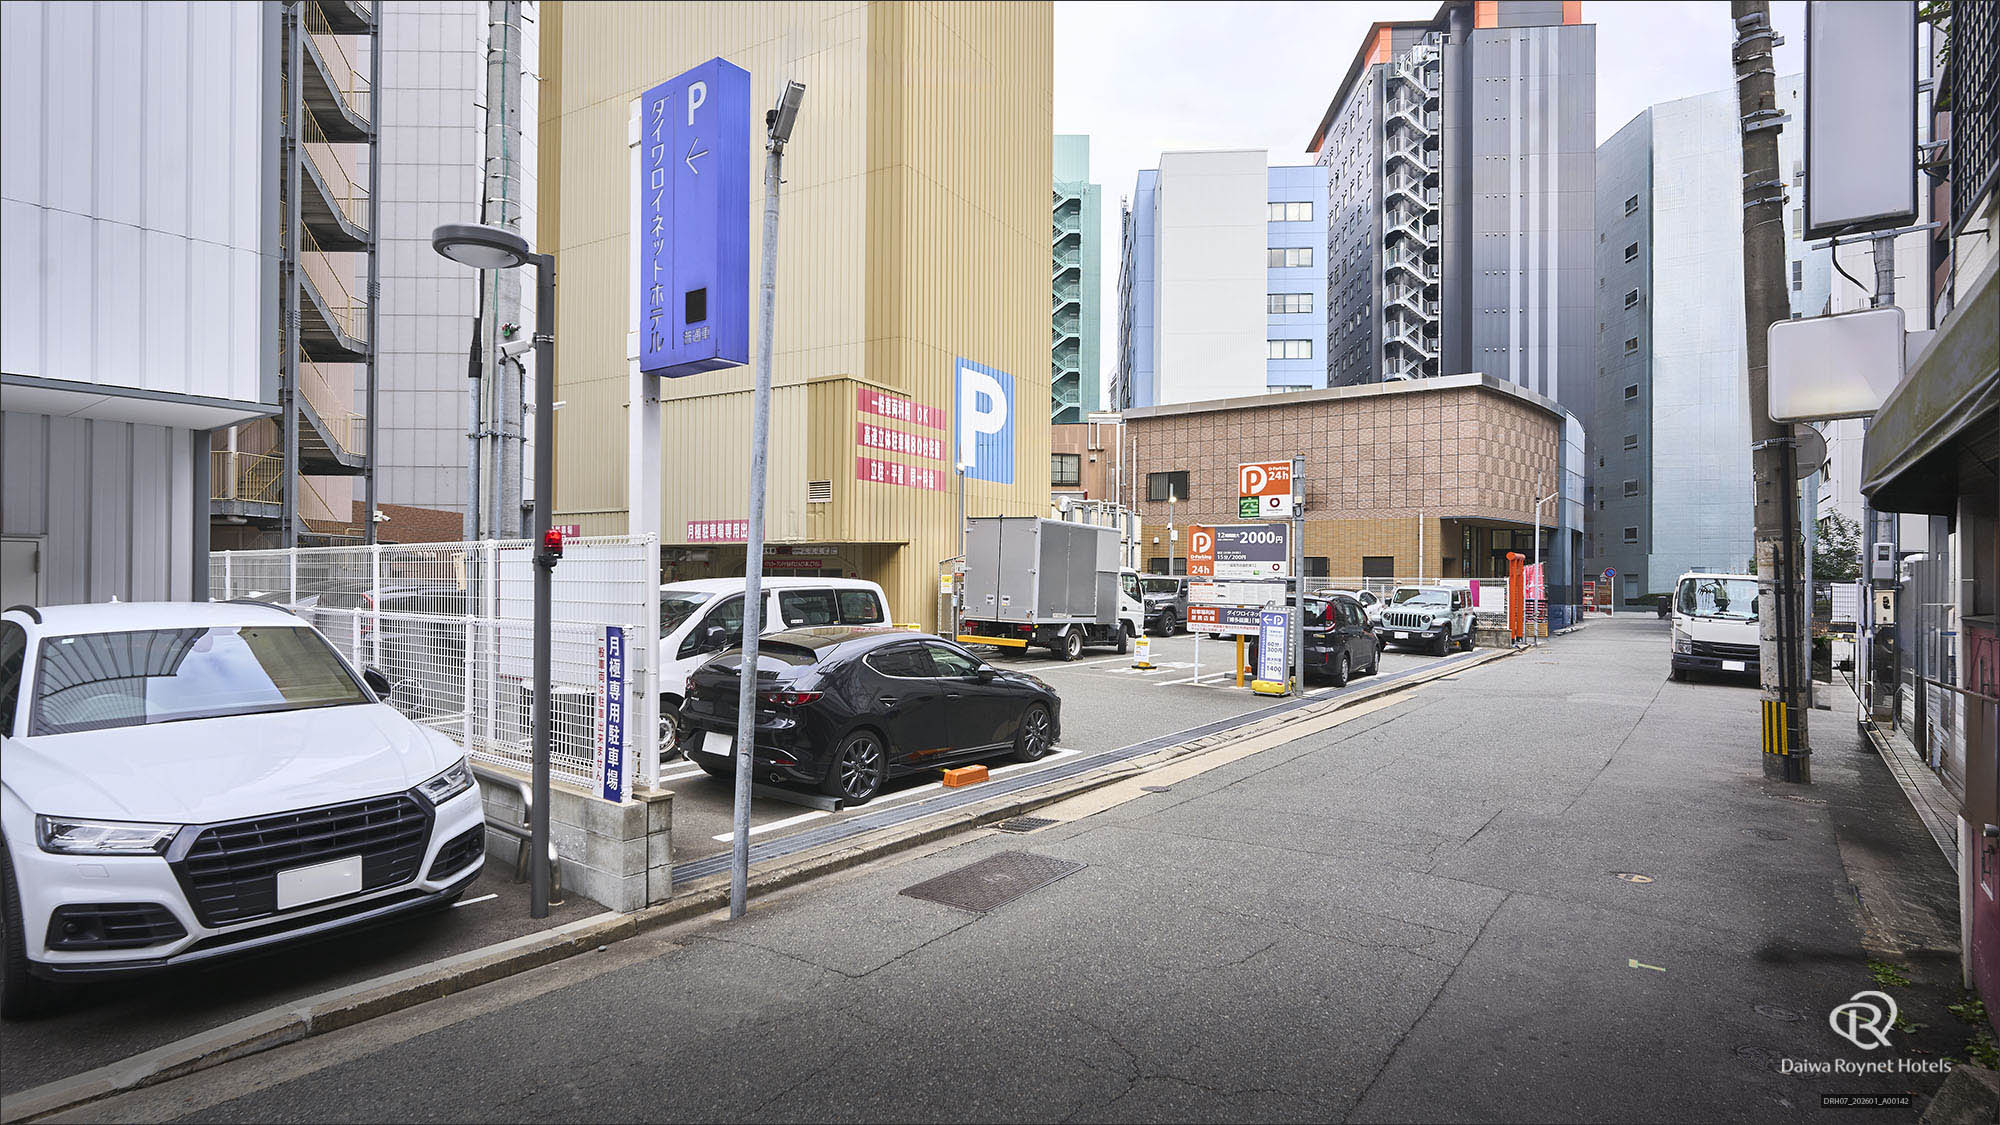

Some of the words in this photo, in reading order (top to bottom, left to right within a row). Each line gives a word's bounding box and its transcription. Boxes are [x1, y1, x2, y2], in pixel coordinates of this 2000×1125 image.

[687, 81, 707, 126] P
[649, 95, 670, 355] ダイワロイネットホテル
[917, 406, 929, 424] OK
[961, 366, 1008, 468] P
[1268, 471, 1289, 481] 24h
[1240, 497, 1259, 517] 空
[1191, 565, 1210, 575] 24h
[606, 636, 621, 791] 月極専用駐車場
